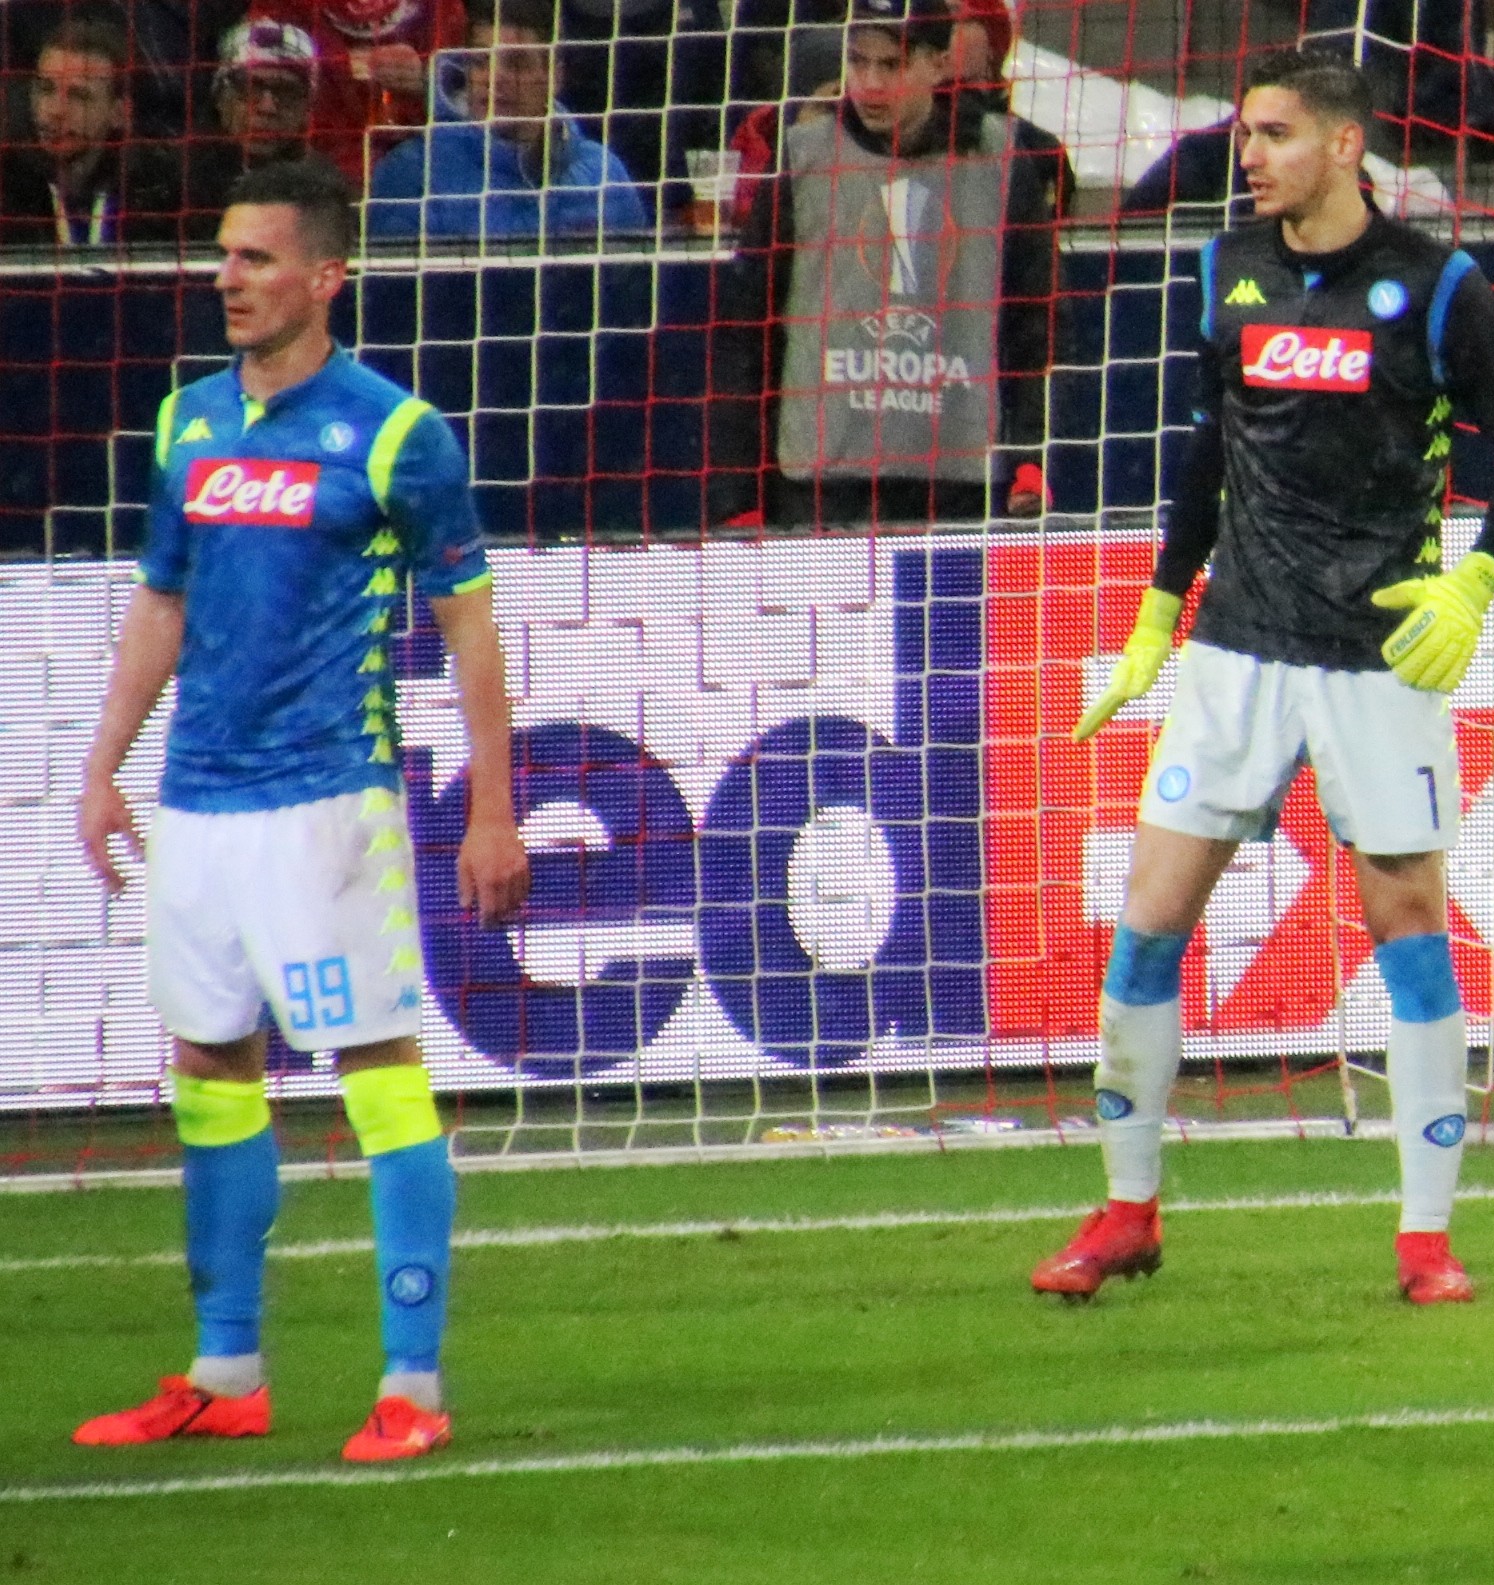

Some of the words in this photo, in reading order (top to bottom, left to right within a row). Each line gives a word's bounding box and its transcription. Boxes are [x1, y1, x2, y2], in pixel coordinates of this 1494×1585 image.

[825, 349, 971, 388] EUROPA
[1243, 331, 1371, 382] Lete
[850, 389, 942, 414] LEAGUE
[183, 464, 313, 516] Lete
[1416, 766, 1440, 831] 1
[283, 954, 354, 1030] 99
